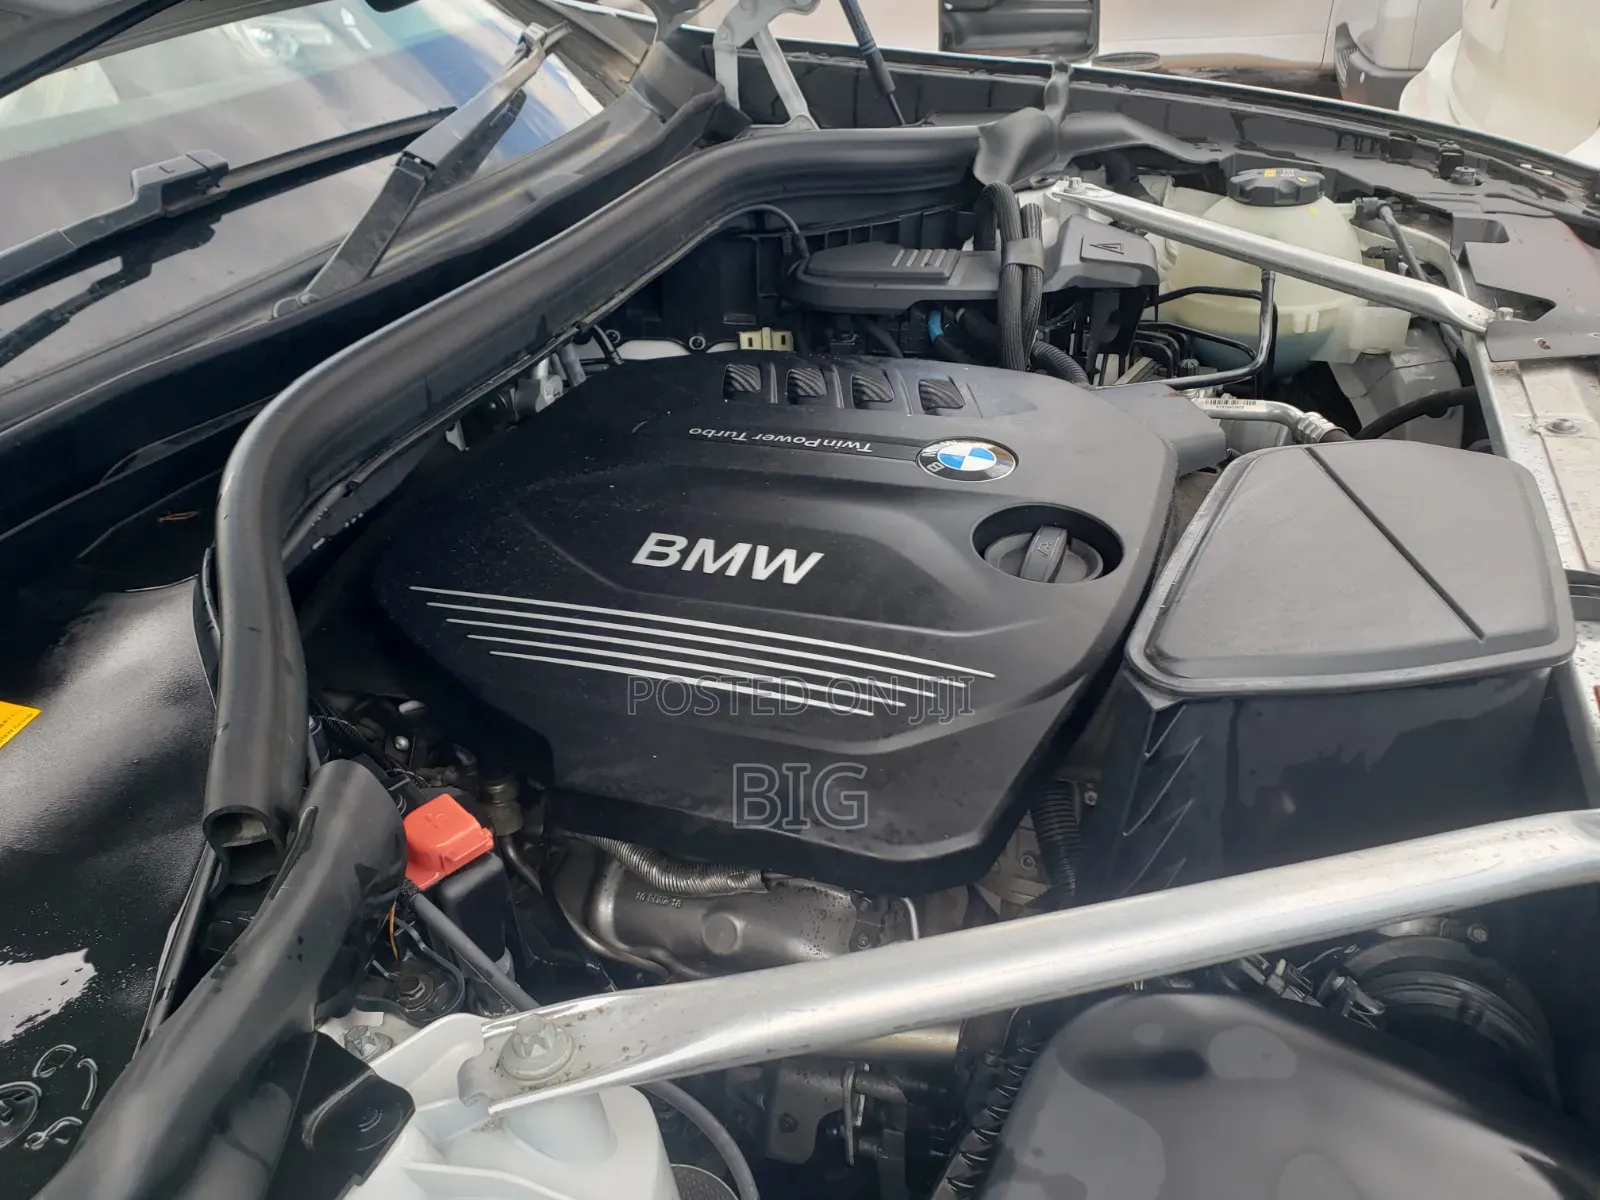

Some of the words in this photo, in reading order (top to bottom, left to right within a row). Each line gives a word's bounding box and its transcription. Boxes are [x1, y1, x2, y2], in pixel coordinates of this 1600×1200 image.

[688, 427, 748, 442] Turbo
[751, 433, 873, 453] TwinPower
[631, 532, 825, 585] BMW
